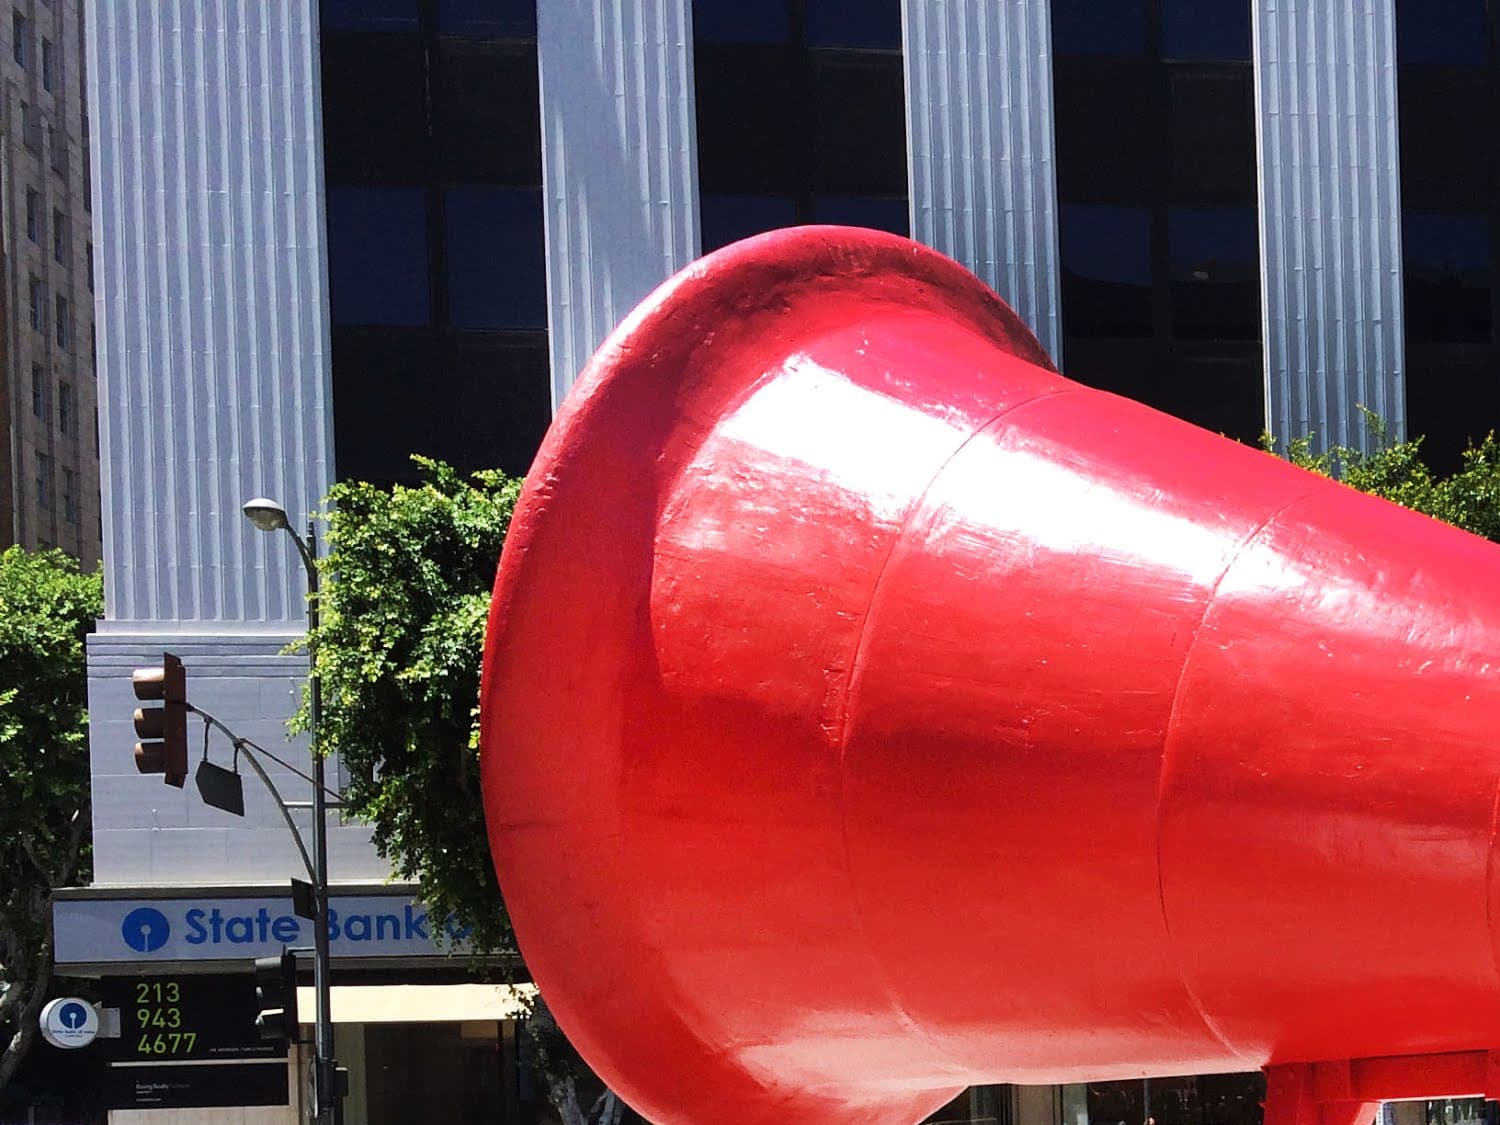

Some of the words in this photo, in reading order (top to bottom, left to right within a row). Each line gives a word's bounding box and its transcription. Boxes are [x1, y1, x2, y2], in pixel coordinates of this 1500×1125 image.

[184, 908, 300, 945] State
[136, 983, 180, 1004] 213
[136, 1008, 182, 1029] 943
[137, 1033, 197, 1055] 4677
